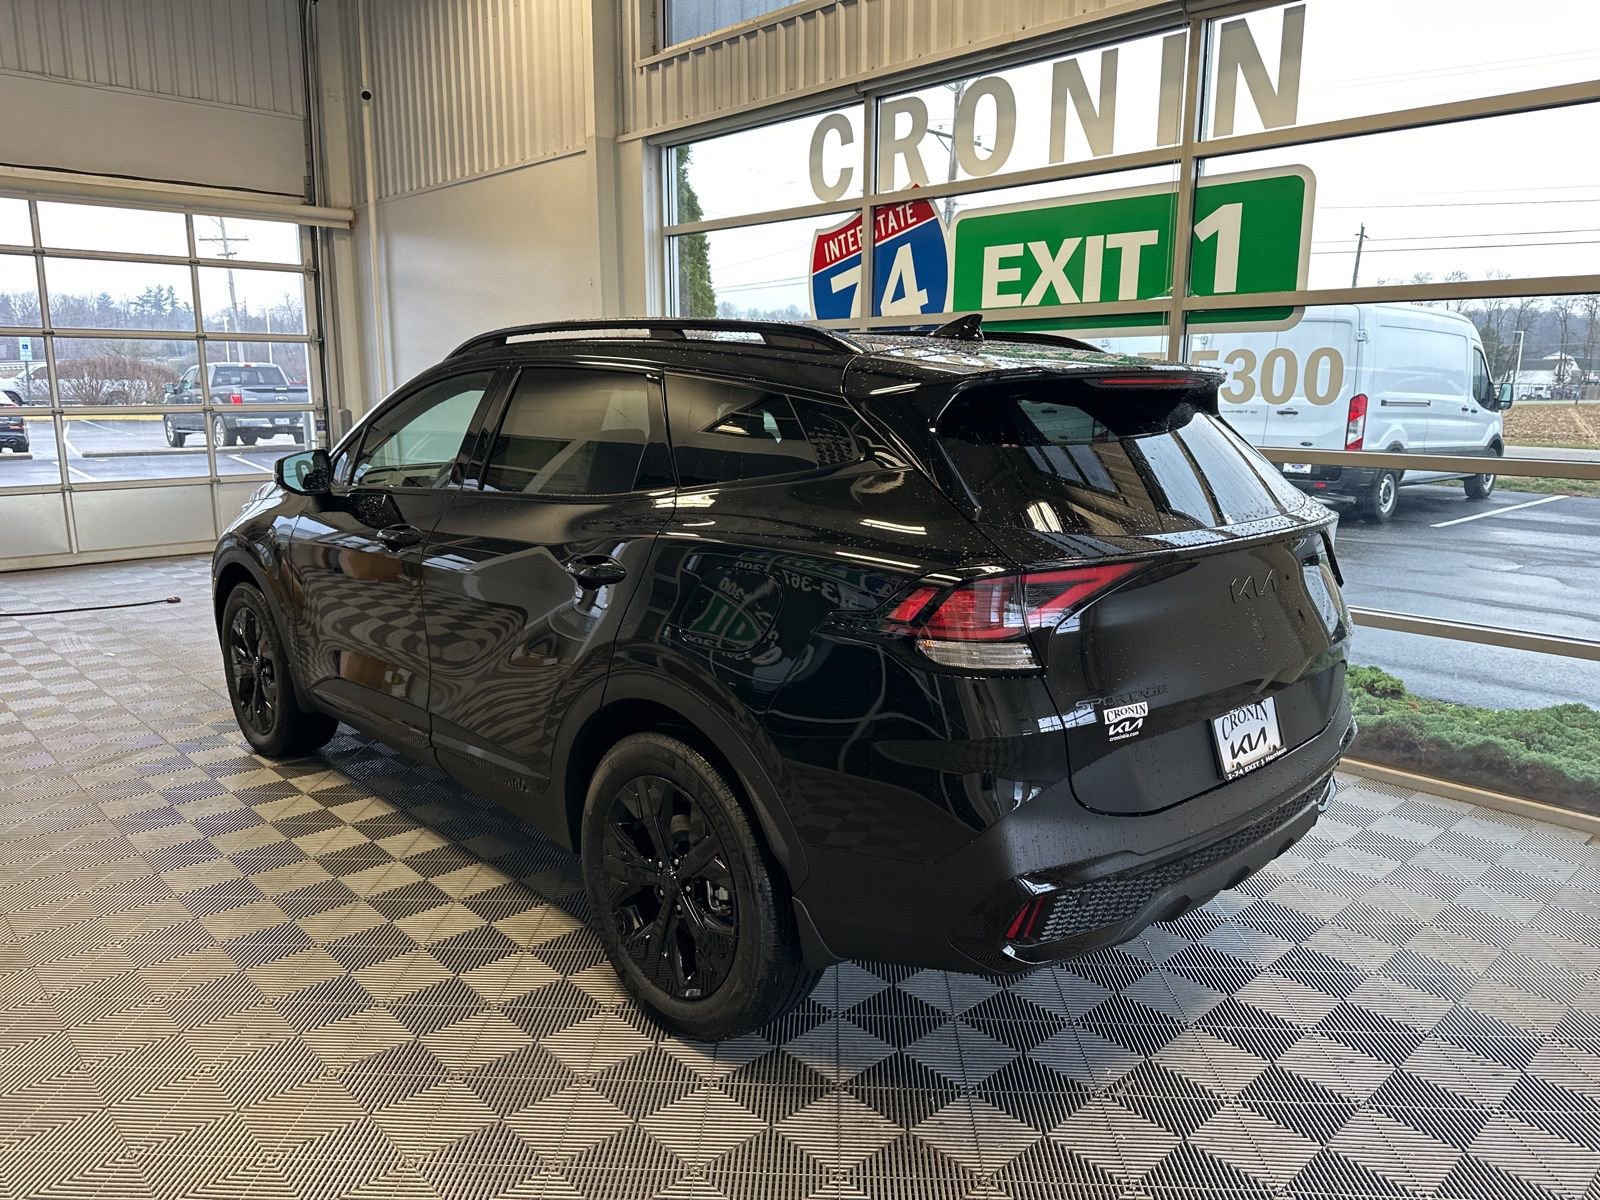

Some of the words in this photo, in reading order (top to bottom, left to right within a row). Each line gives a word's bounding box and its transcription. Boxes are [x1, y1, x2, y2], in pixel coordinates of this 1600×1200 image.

[809, 5, 1306, 202] CRONIN
[824, 202, 917, 263] INTETATE
[981, 230, 1159, 309] EXIT
[1193, 202, 1243, 294] 1
[830, 242, 929, 319] 74
[1106, 703, 1146, 723] CRONIN
[1221, 700, 1269, 741] CRONIN
[1244, 760, 1260, 772] EXIT
